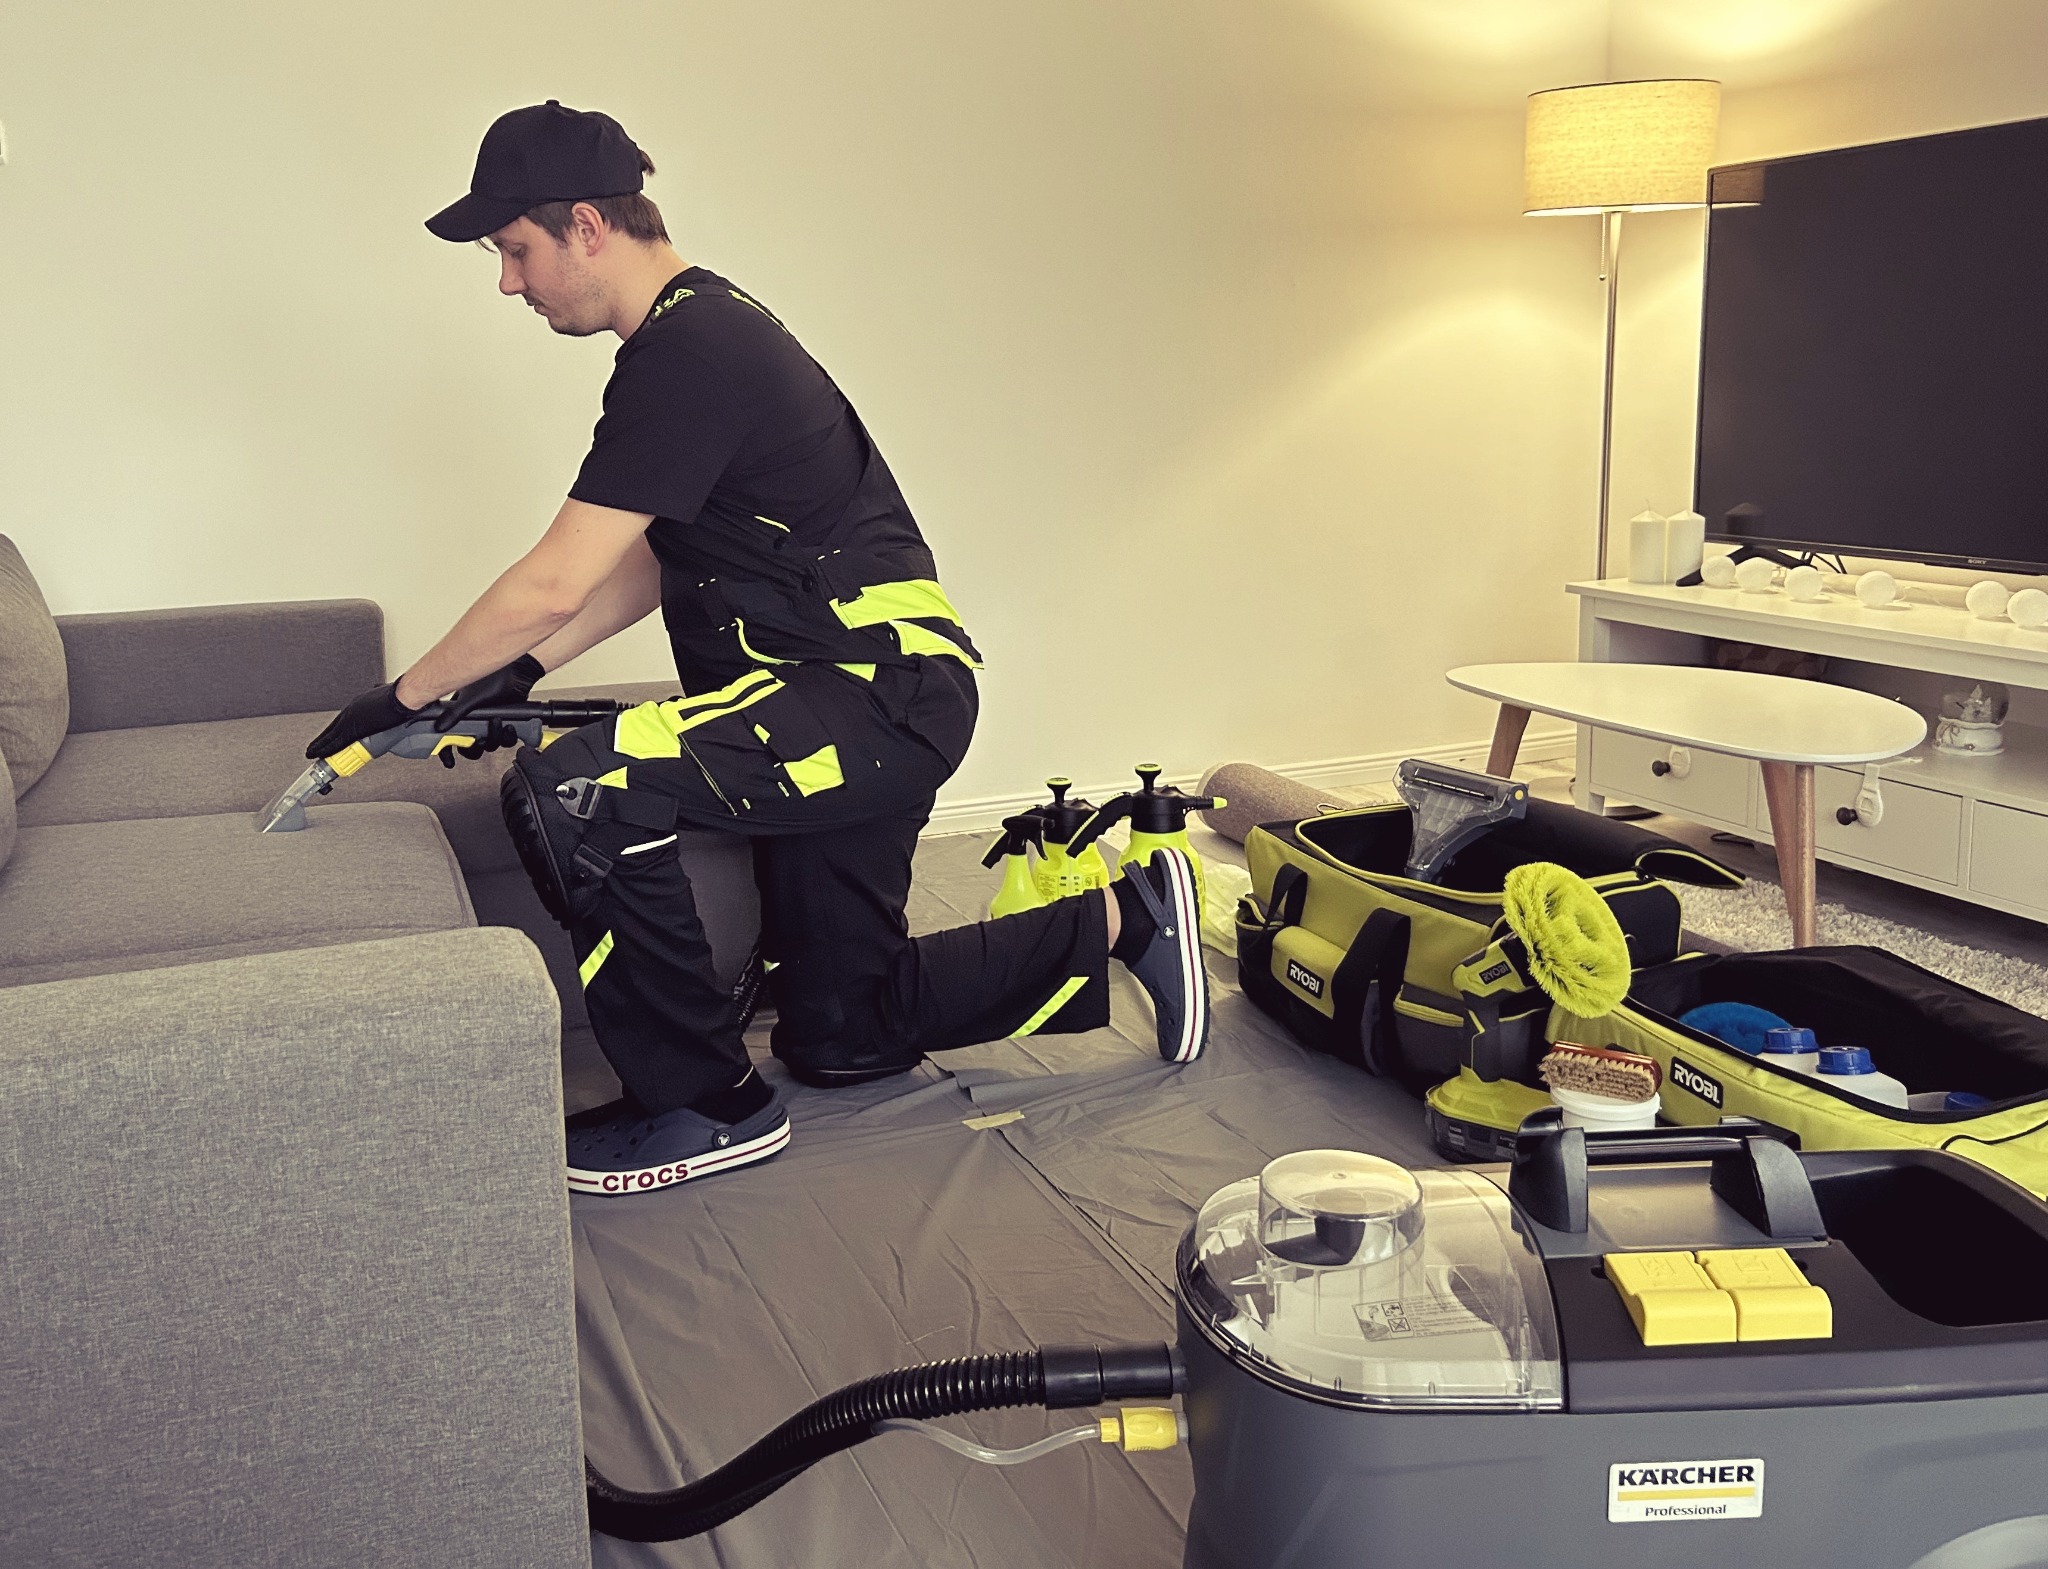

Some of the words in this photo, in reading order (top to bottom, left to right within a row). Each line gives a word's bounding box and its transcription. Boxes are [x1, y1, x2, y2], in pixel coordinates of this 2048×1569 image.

[1290, 963, 1320, 993] RYOBI
[1481, 962, 1509, 981] RYOBI
[1674, 1063, 1720, 1104] RYOBI
[602, 1163, 689, 1192] crocs
[1617, 1465, 1755, 1486] KÄRCHER
[1645, 1504, 1726, 1517] Professional
